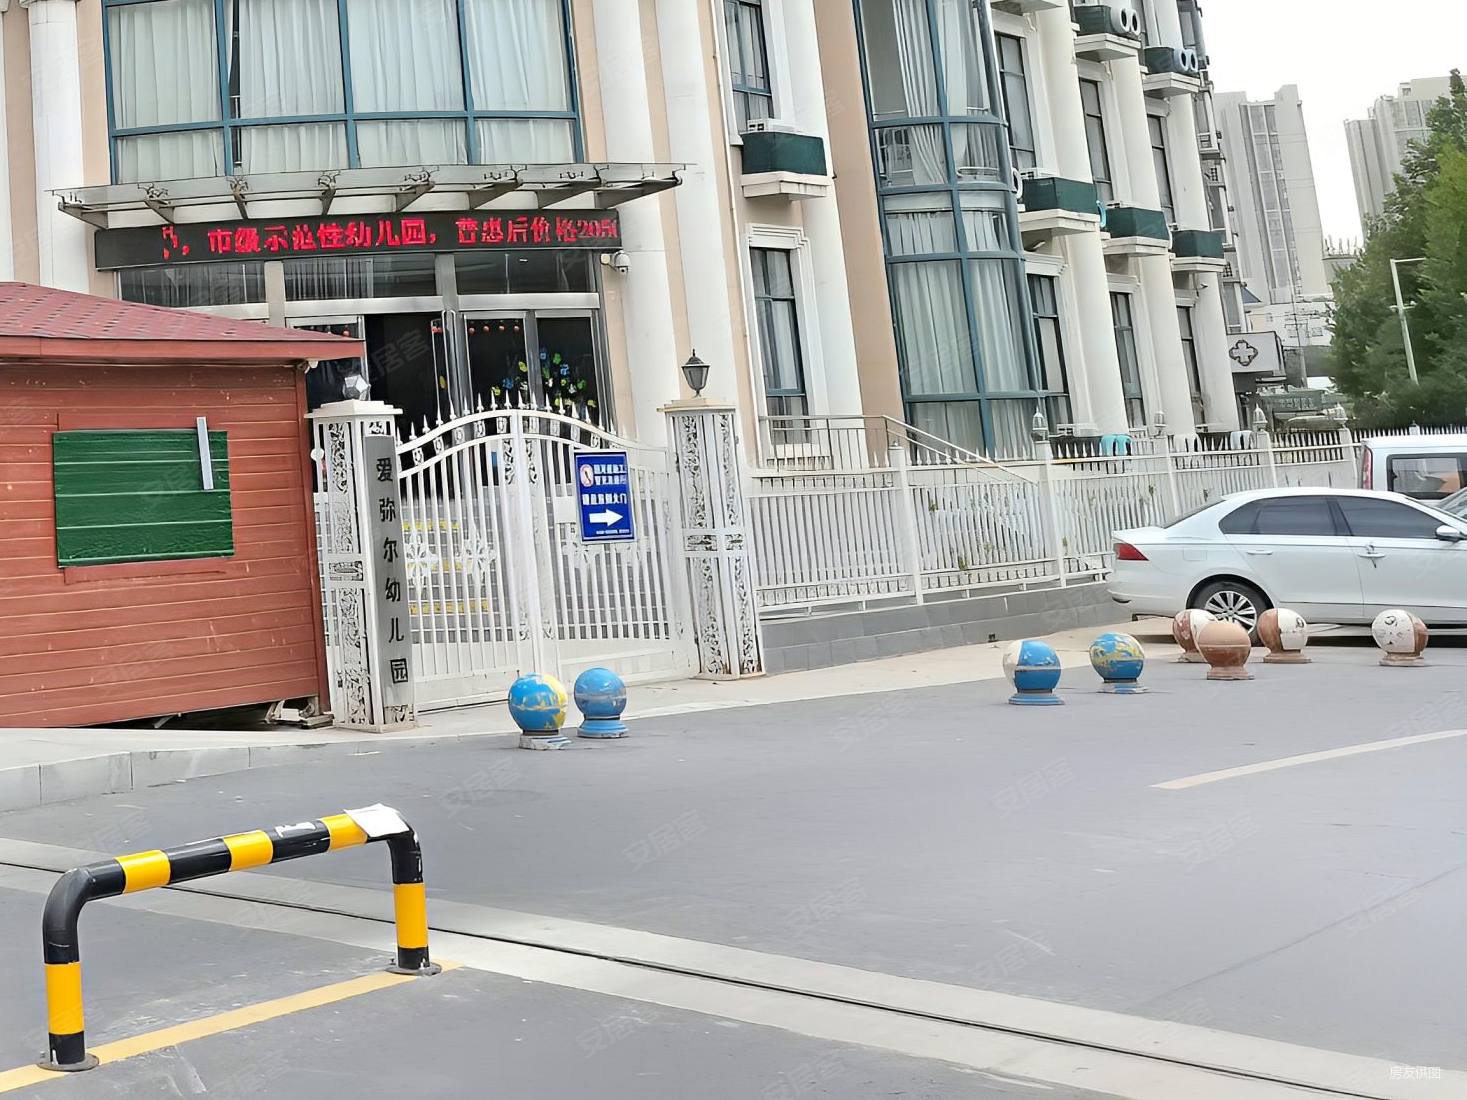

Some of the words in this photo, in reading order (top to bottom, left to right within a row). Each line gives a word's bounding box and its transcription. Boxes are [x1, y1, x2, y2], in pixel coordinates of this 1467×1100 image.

[376, 456, 409, 684] 爱弥尔幼儿园
